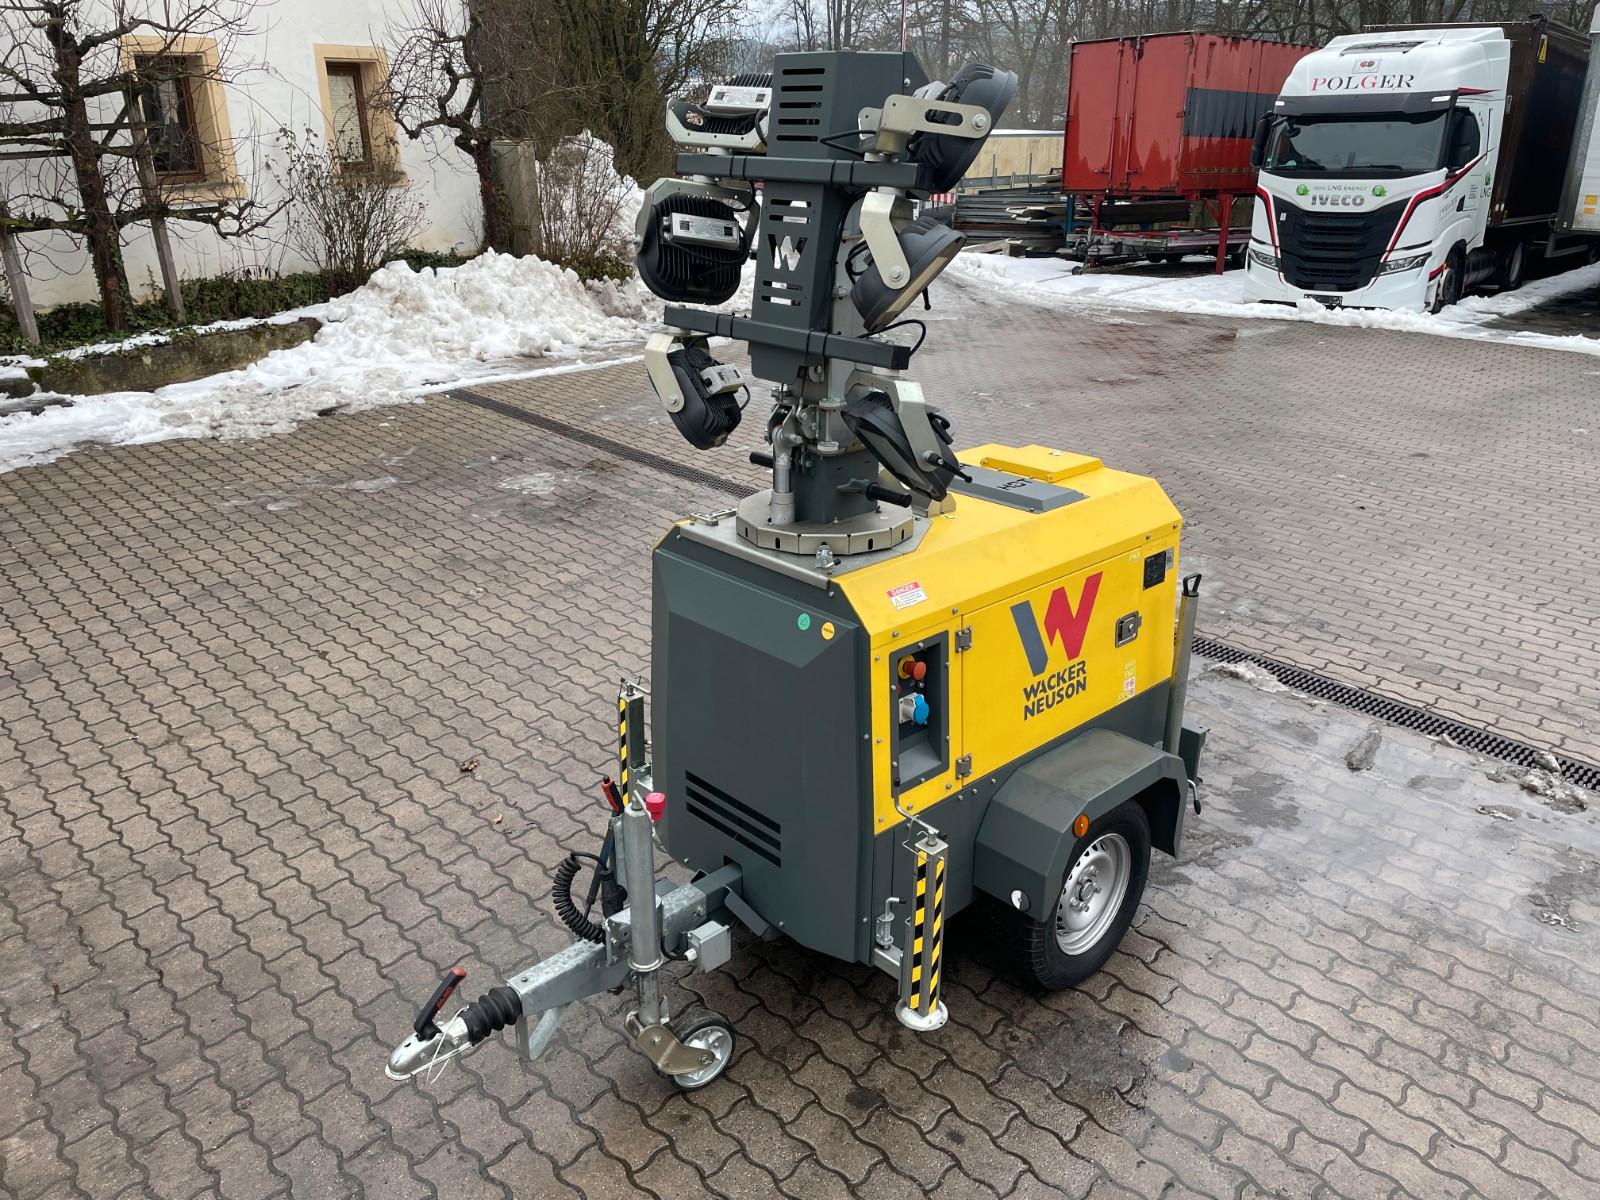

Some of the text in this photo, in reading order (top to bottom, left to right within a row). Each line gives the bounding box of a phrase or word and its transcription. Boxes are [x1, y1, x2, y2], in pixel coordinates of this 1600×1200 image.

[1312, 74, 1414, 91] POLGER
[1312, 195, 1364, 206] IVECO
[1023, 660, 1086, 701] WACKER
[1024, 676, 1086, 721] NEUSON
